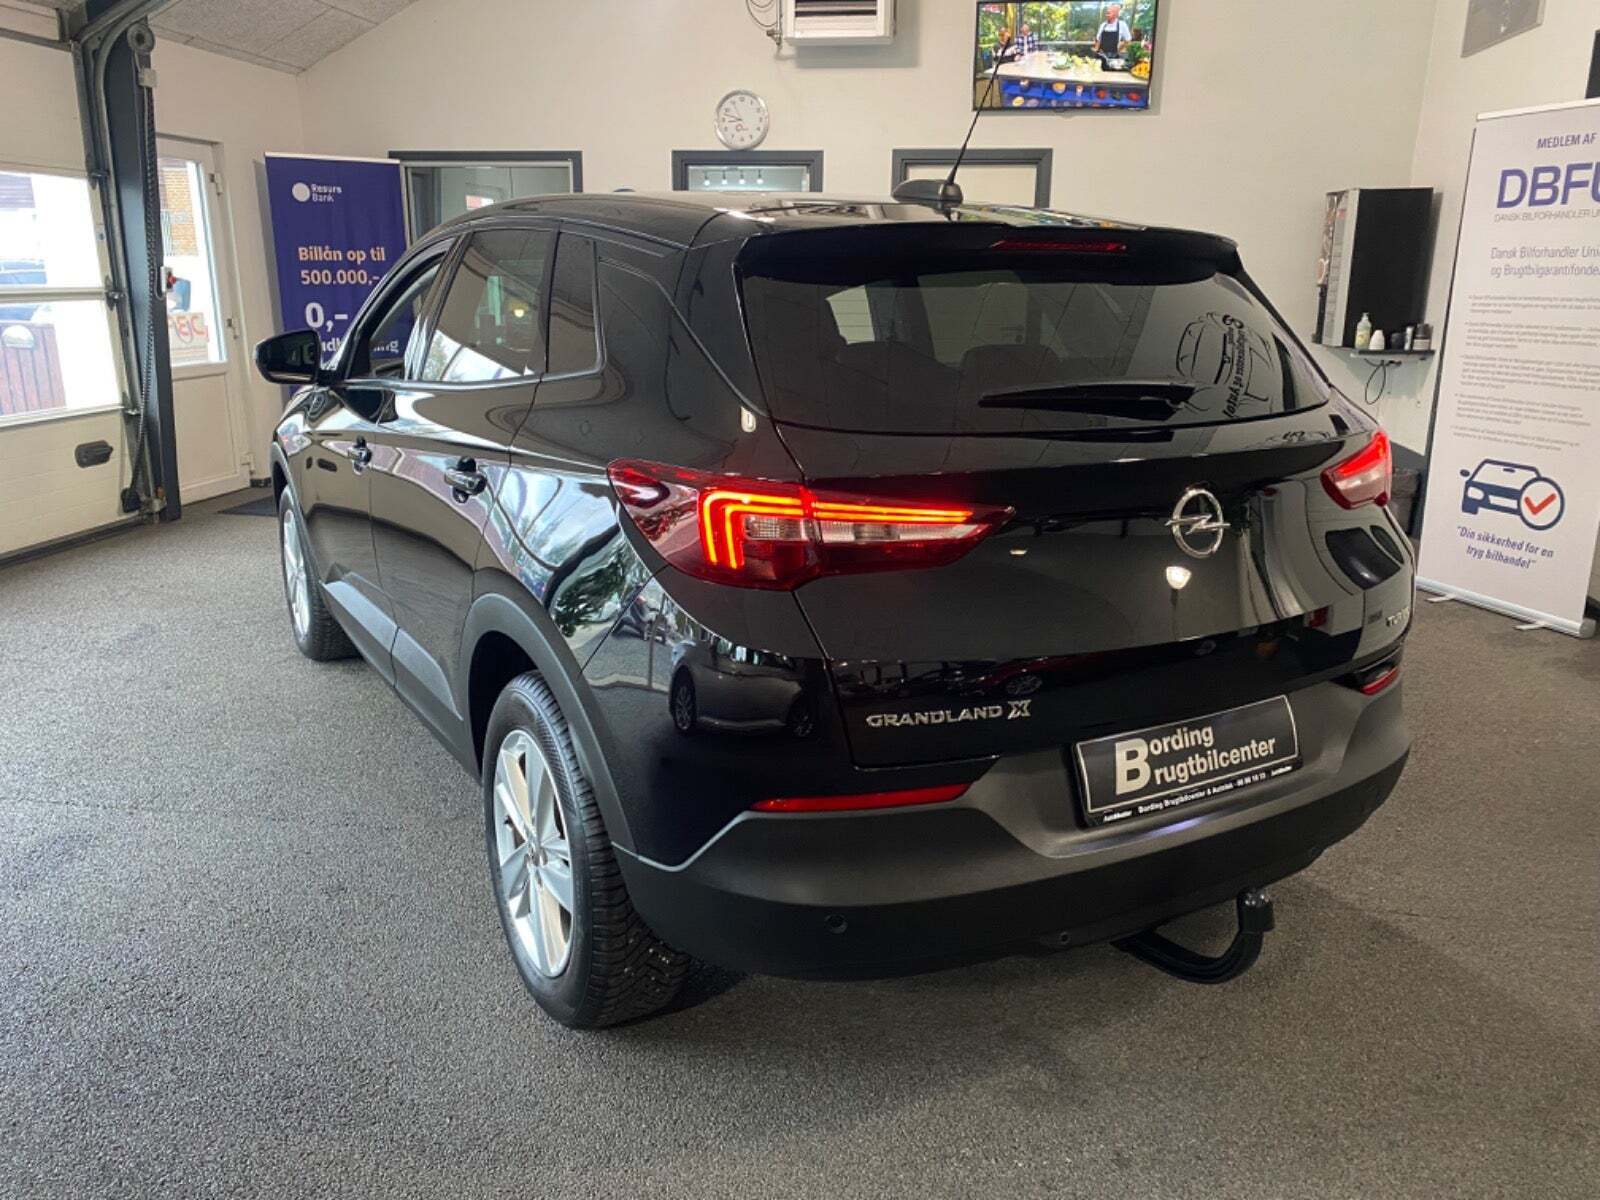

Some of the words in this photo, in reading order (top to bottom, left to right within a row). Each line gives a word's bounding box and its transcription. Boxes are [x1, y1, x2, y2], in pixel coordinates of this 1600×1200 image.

[1537, 134, 1581, 150] MEDLEM
[1582, 131, 1598, 144] AF
[298, 245, 342, 261] Billån
[346, 250, 367, 265] op
[370, 246, 386, 261] til
[305, 301, 349, 332] 0,-
[1466, 544, 1484, 560] tryg
[1477, 530, 1525, 551] sikkerhed
[1525, 542, 1539, 555] for
[1541, 546, 1554, 558] en
[866, 705, 1003, 728] GRANDLAND
[1007, 699, 1032, 720] X
